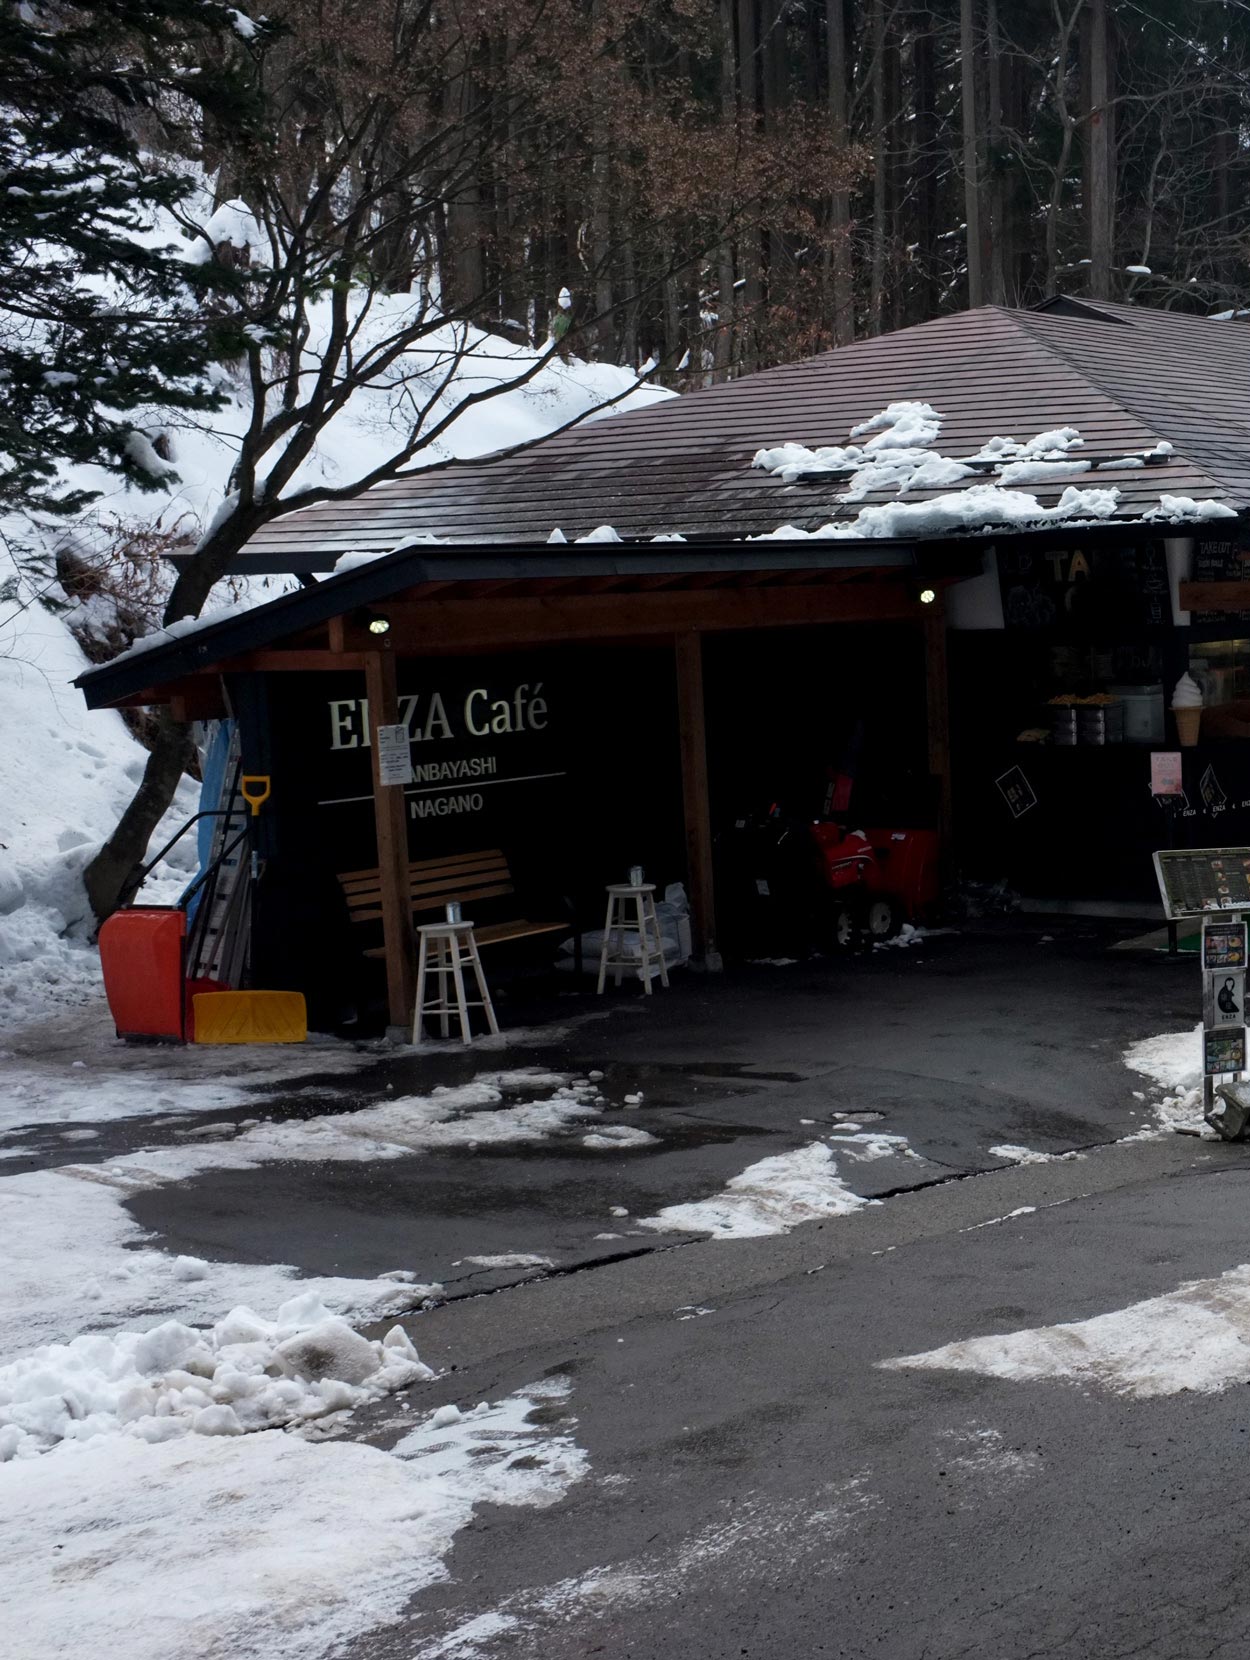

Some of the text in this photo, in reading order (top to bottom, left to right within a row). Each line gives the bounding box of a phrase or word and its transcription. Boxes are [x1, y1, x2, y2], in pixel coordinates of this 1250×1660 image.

[464, 682, 549, 737] Café
[411, 755, 498, 784] ANBAYASHI
[410, 793, 484, 820] NAGANO
